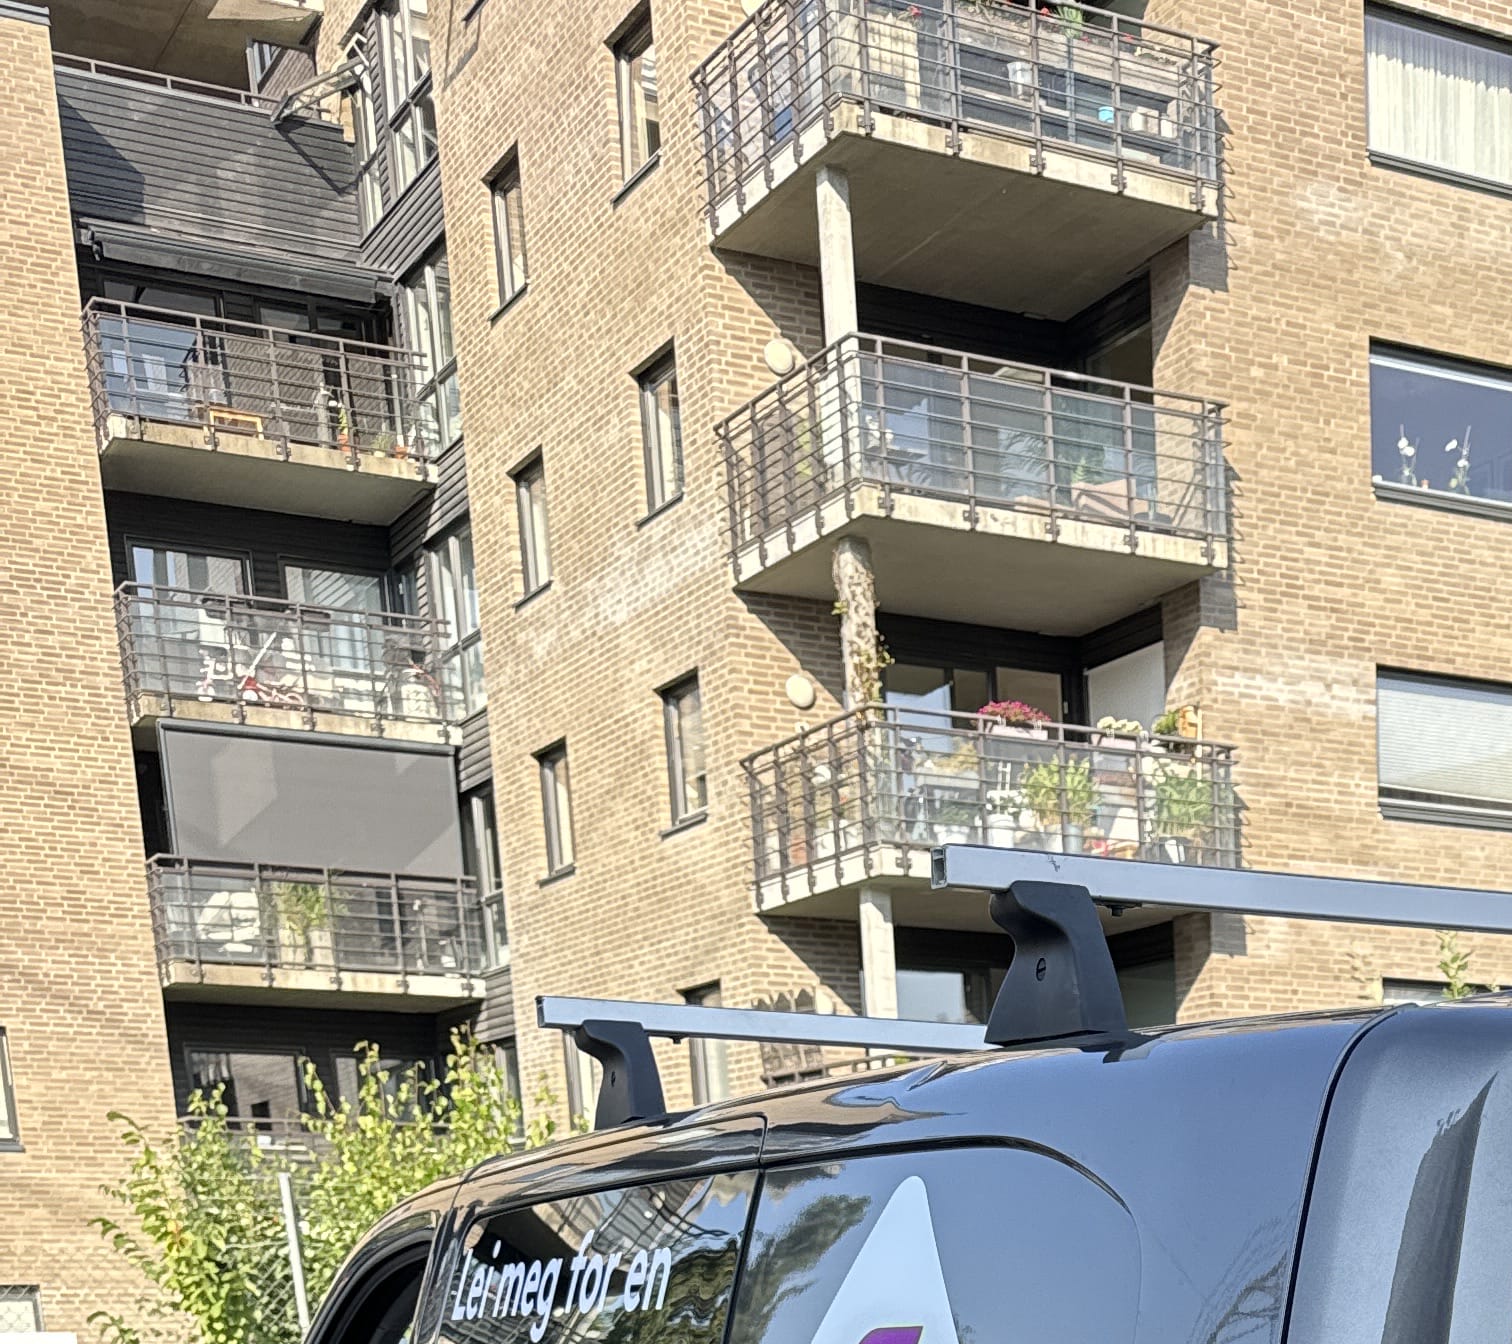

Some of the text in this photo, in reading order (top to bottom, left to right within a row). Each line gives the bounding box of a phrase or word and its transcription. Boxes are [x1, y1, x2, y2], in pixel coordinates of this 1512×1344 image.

[450, 1230, 672, 1344] Lei meg for en
